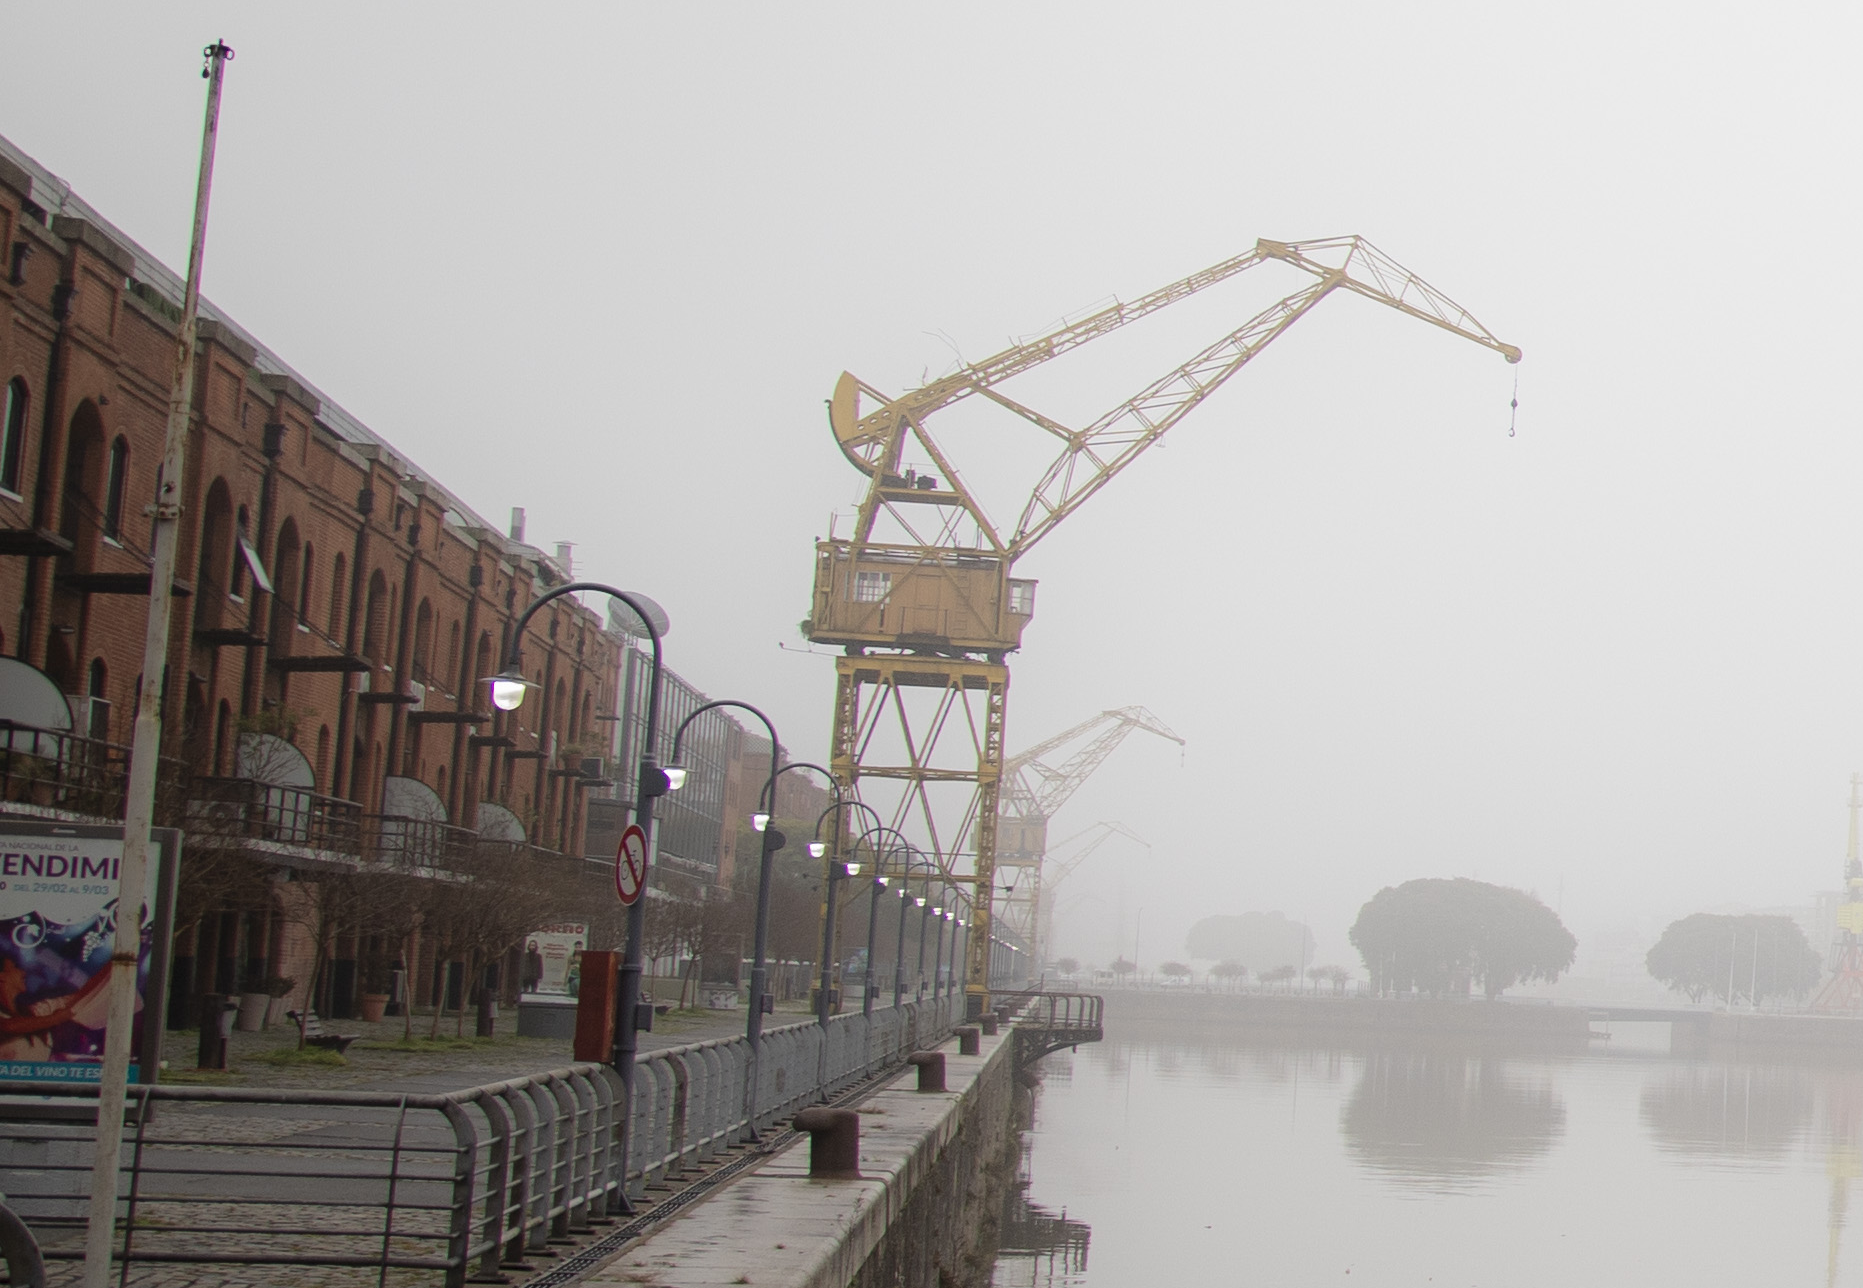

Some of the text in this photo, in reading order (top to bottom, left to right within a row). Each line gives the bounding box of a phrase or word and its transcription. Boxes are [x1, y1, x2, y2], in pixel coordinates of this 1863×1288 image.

[9, 842, 53, 851] NACIONAL
[68, 844, 79, 852] LA
[0, 852, 119, 880] ENDIMI
[33, 882, 68, 894] 29/02
[82, 884, 109, 895] 9/03
[10, 1065, 33, 1077] DEL
[35, 1066, 68, 1078] VINO
[69, 1067, 84, 1079] TE
